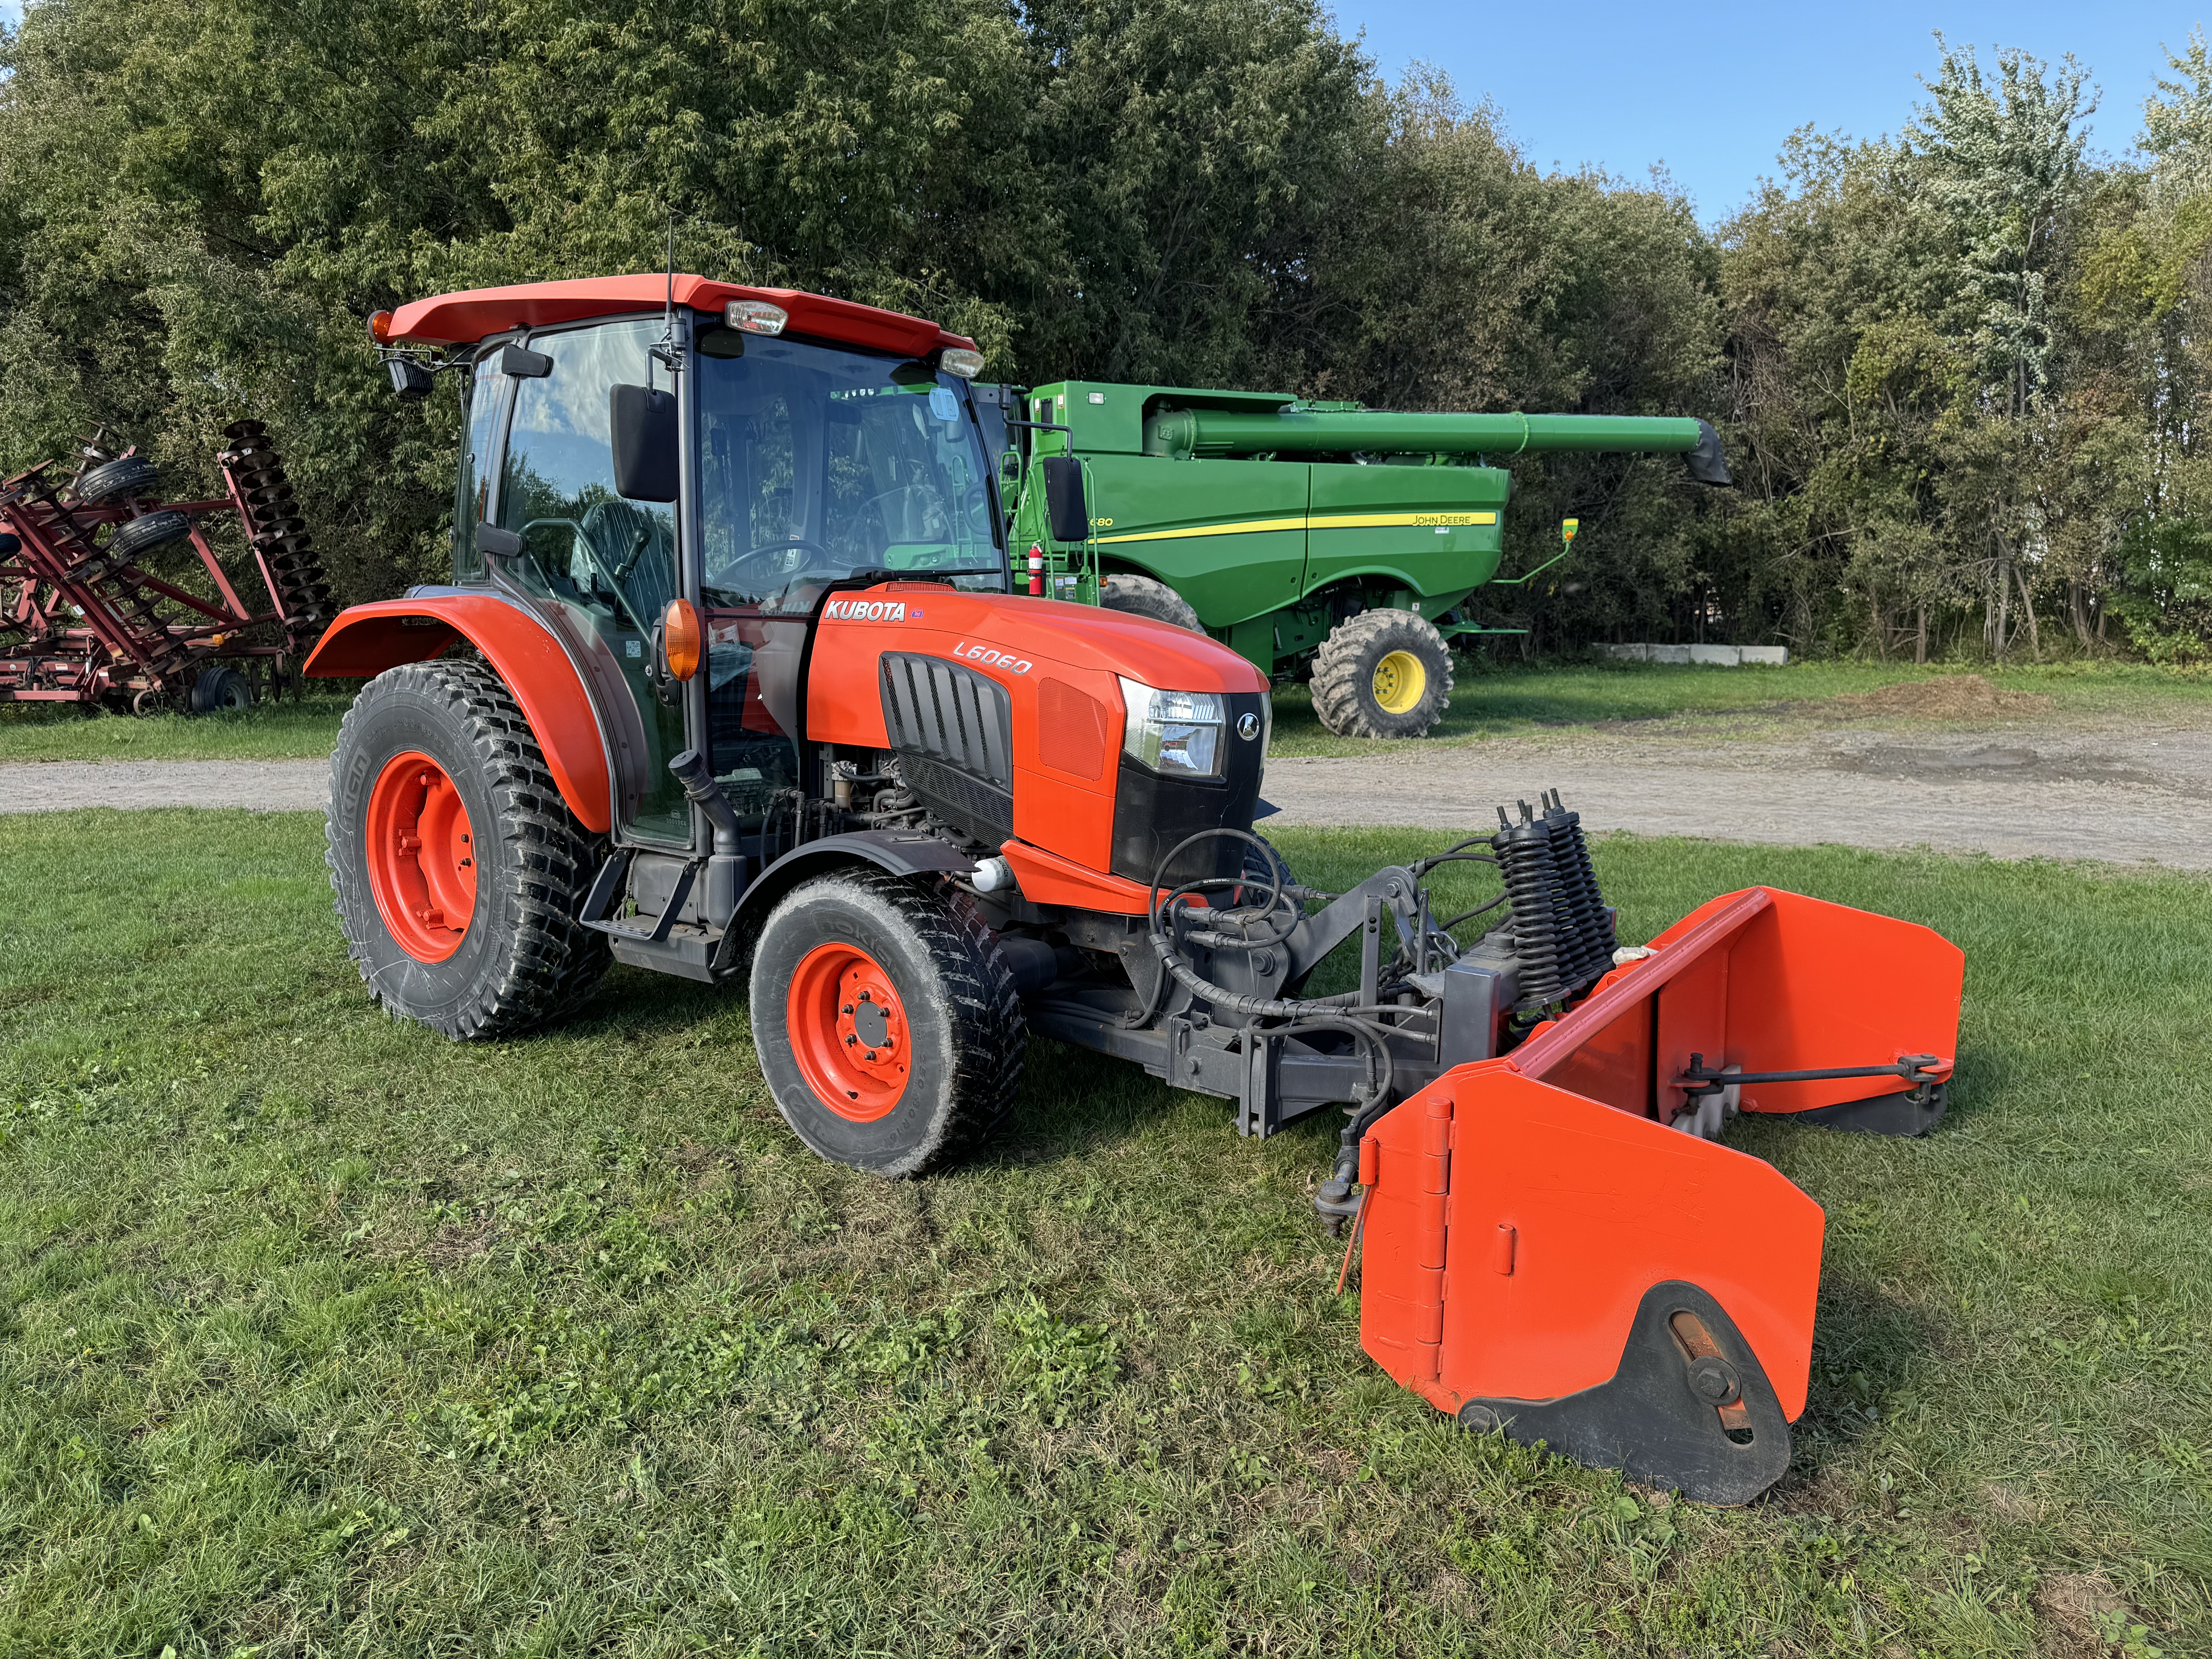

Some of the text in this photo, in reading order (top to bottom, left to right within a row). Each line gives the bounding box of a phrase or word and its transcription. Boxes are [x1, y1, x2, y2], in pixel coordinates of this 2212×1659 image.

[1088, 517, 1113, 526] 680
[1412, 515, 1470, 524] JOHN DEERE
[824, 600, 906, 622] KUBOTA
[953, 642, 1033, 675] L6060
